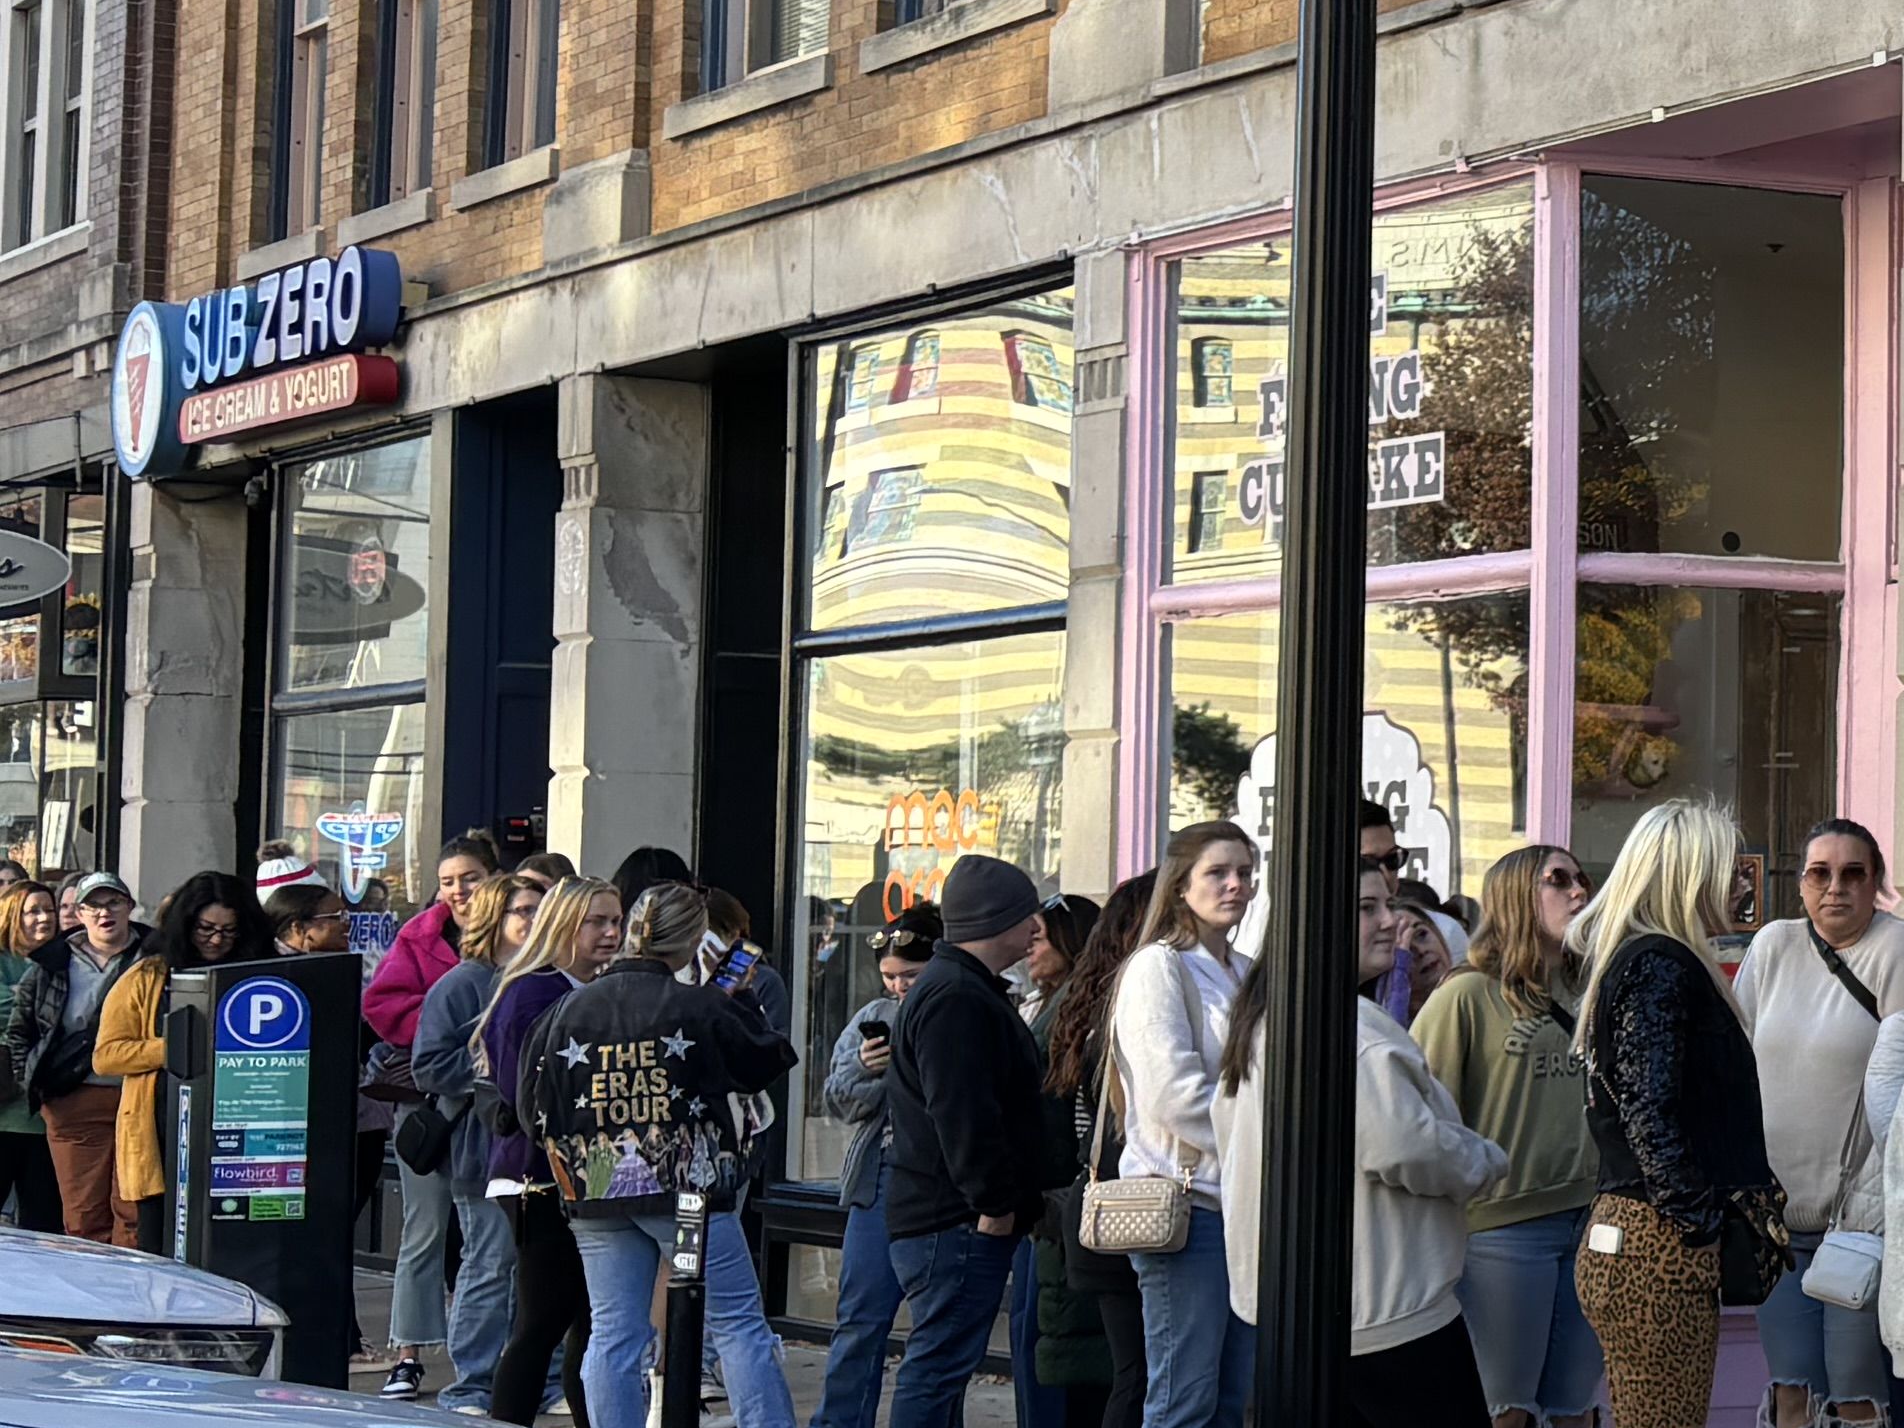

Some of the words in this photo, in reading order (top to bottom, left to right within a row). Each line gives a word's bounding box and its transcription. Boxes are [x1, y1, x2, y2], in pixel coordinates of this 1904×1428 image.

[181, 284, 248, 390] SUB
[252, 245, 363, 368] ZERO
[188, 397, 211, 436] ICE
[215, 382, 267, 428] CREAM
[270, 381, 280, 415] &
[284, 362, 351, 412] YOGURT
[1239, 440, 1441, 521] CUKE
[884, 788, 979, 852] mac
[249, 994, 283, 1035] P
[219, 1057, 245, 1068] PAY
[247, 1057, 266, 1067] TO
[270, 1056, 306, 1067] PARK
[598, 1040, 657, 1071] THE
[591, 1068, 669, 1100] ERAS
[590, 1096, 672, 1127] TOUR
